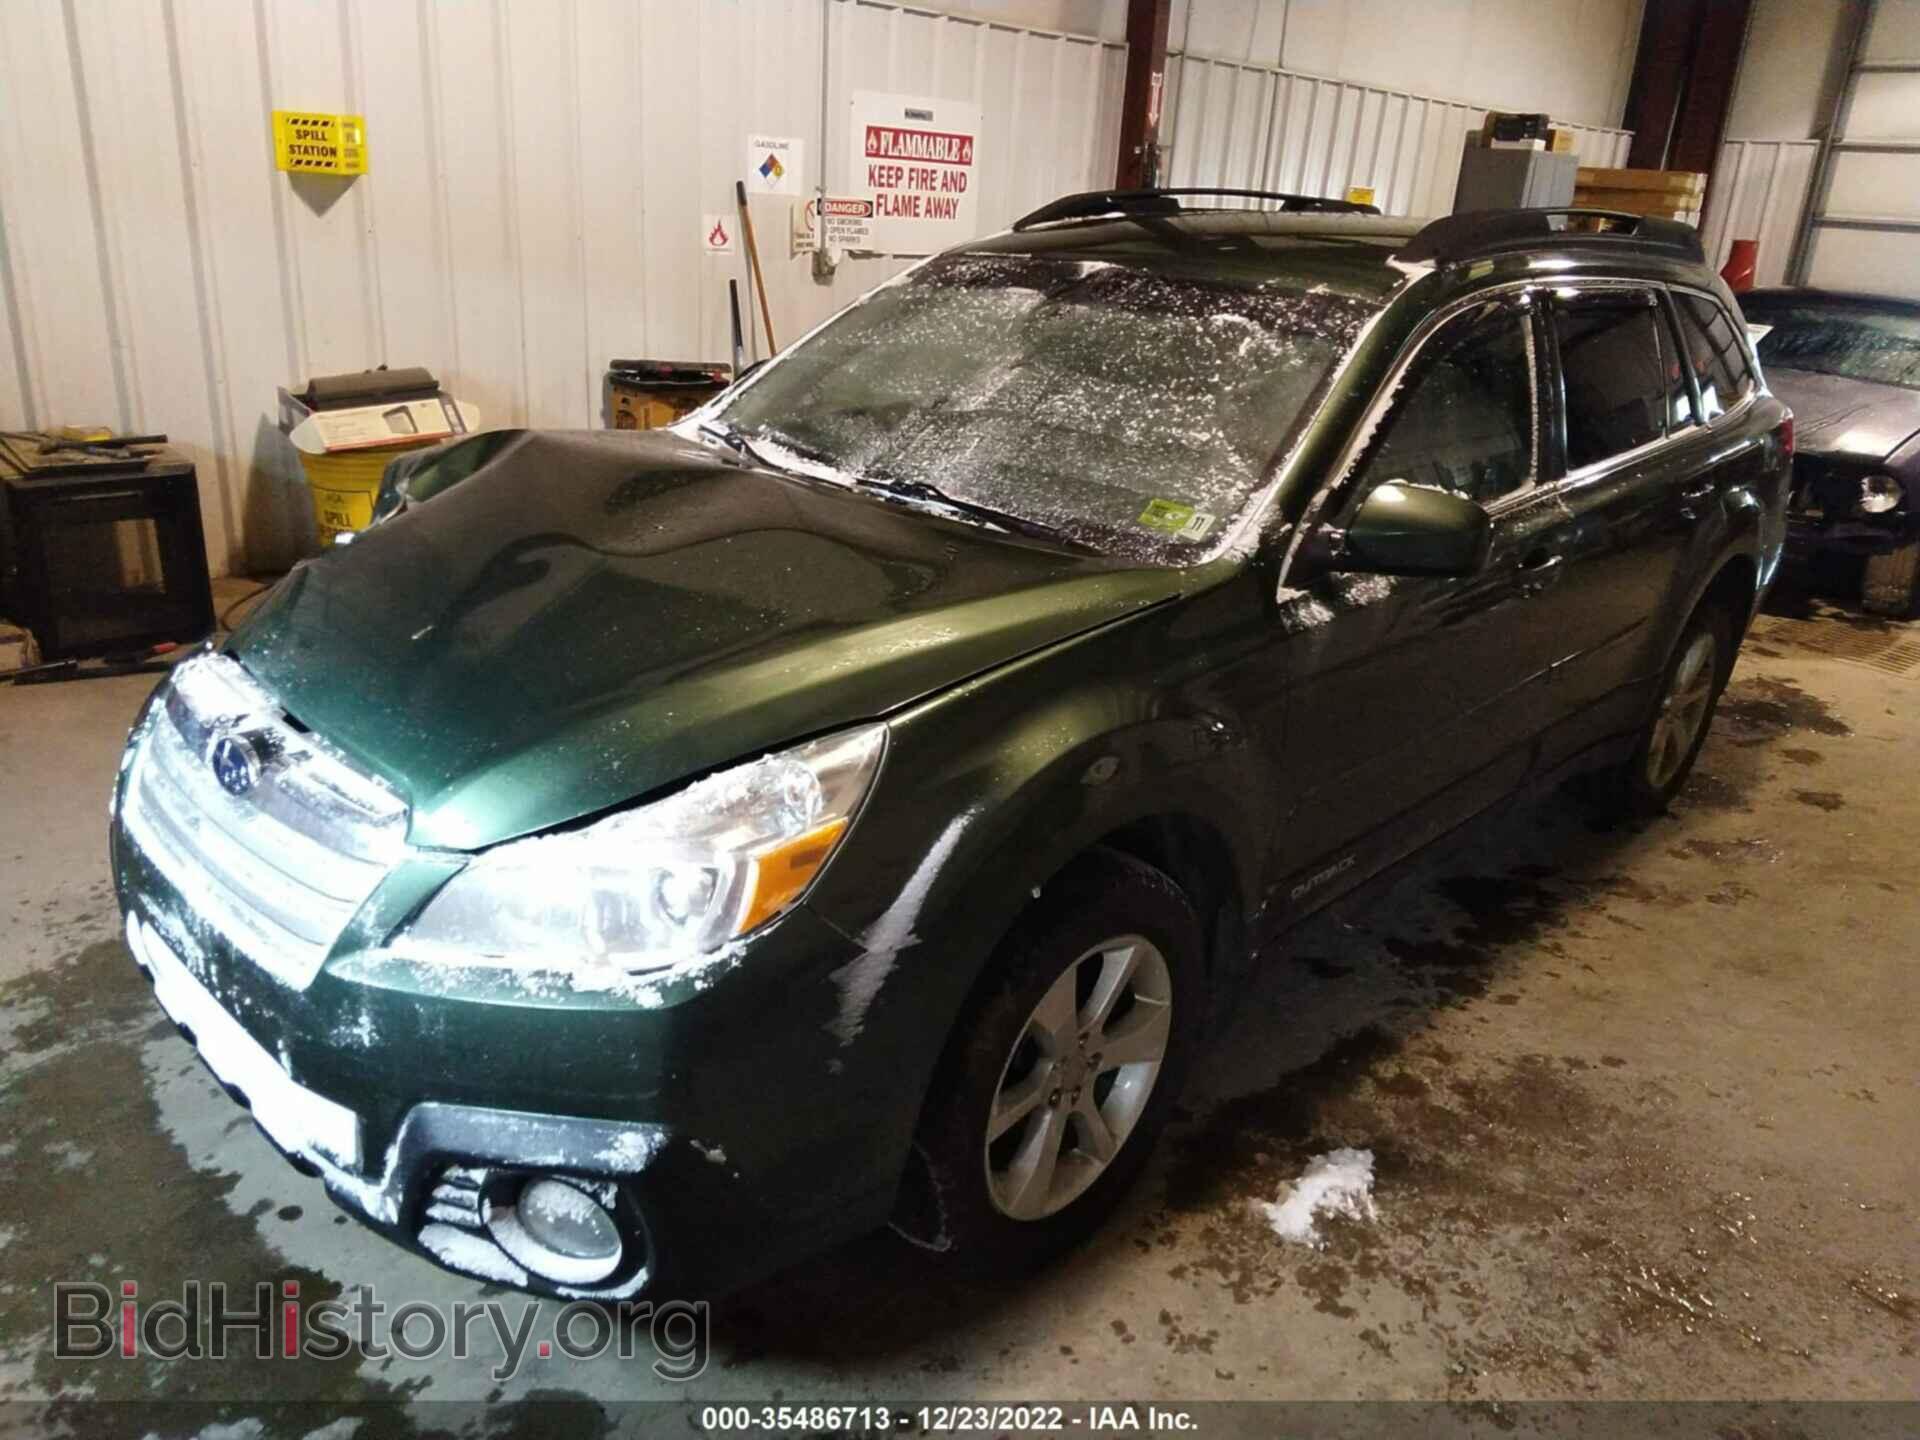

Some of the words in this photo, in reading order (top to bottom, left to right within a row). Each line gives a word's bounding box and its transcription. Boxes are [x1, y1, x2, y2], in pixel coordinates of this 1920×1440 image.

[295, 129, 328, 141] SPILL
[288, 144, 337, 158] STATION
[754, 139, 790, 150] GASOLINE
[880, 130, 960, 162] FLAMMABLE
[867, 164, 904, 189] KEEP
[907, 167, 937, 191] FIRE
[940, 170, 967, 193] AND
[824, 202, 865, 215] DANGER
[876, 193, 921, 217] FLAME
[923, 196, 959, 220] AWAY
[324, 510, 352, 527] SPILL
